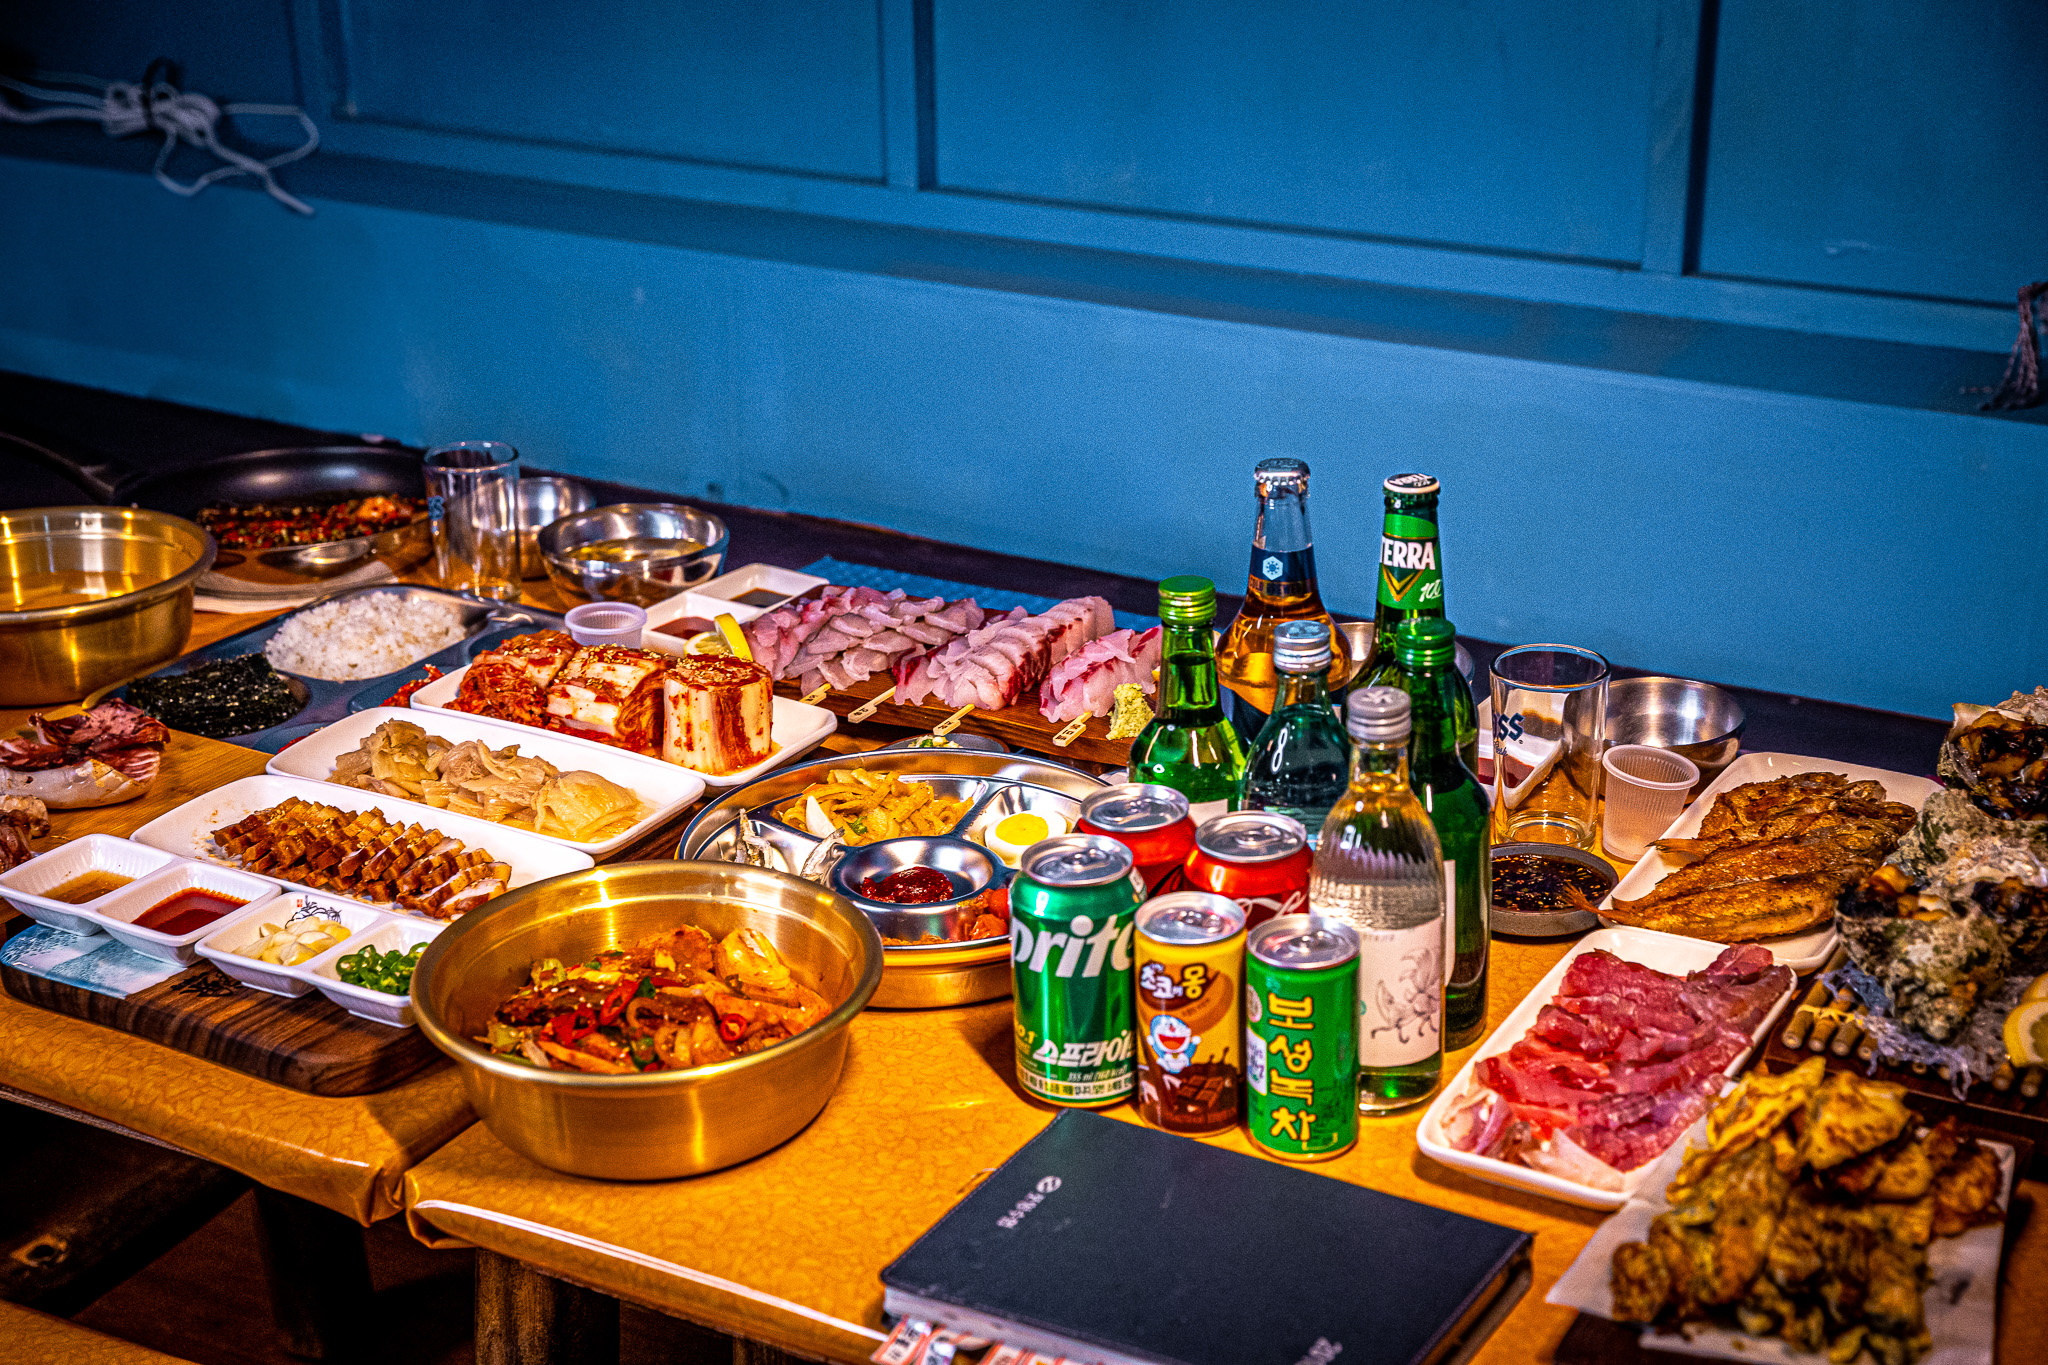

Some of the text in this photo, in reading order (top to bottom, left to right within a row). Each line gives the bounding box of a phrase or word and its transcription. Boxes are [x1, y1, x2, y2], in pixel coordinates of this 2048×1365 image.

[1380, 536, 1436, 570] TERRA
[1011, 914, 1134, 978] prite
[1268, 992, 1317, 1141] 보성녹차
